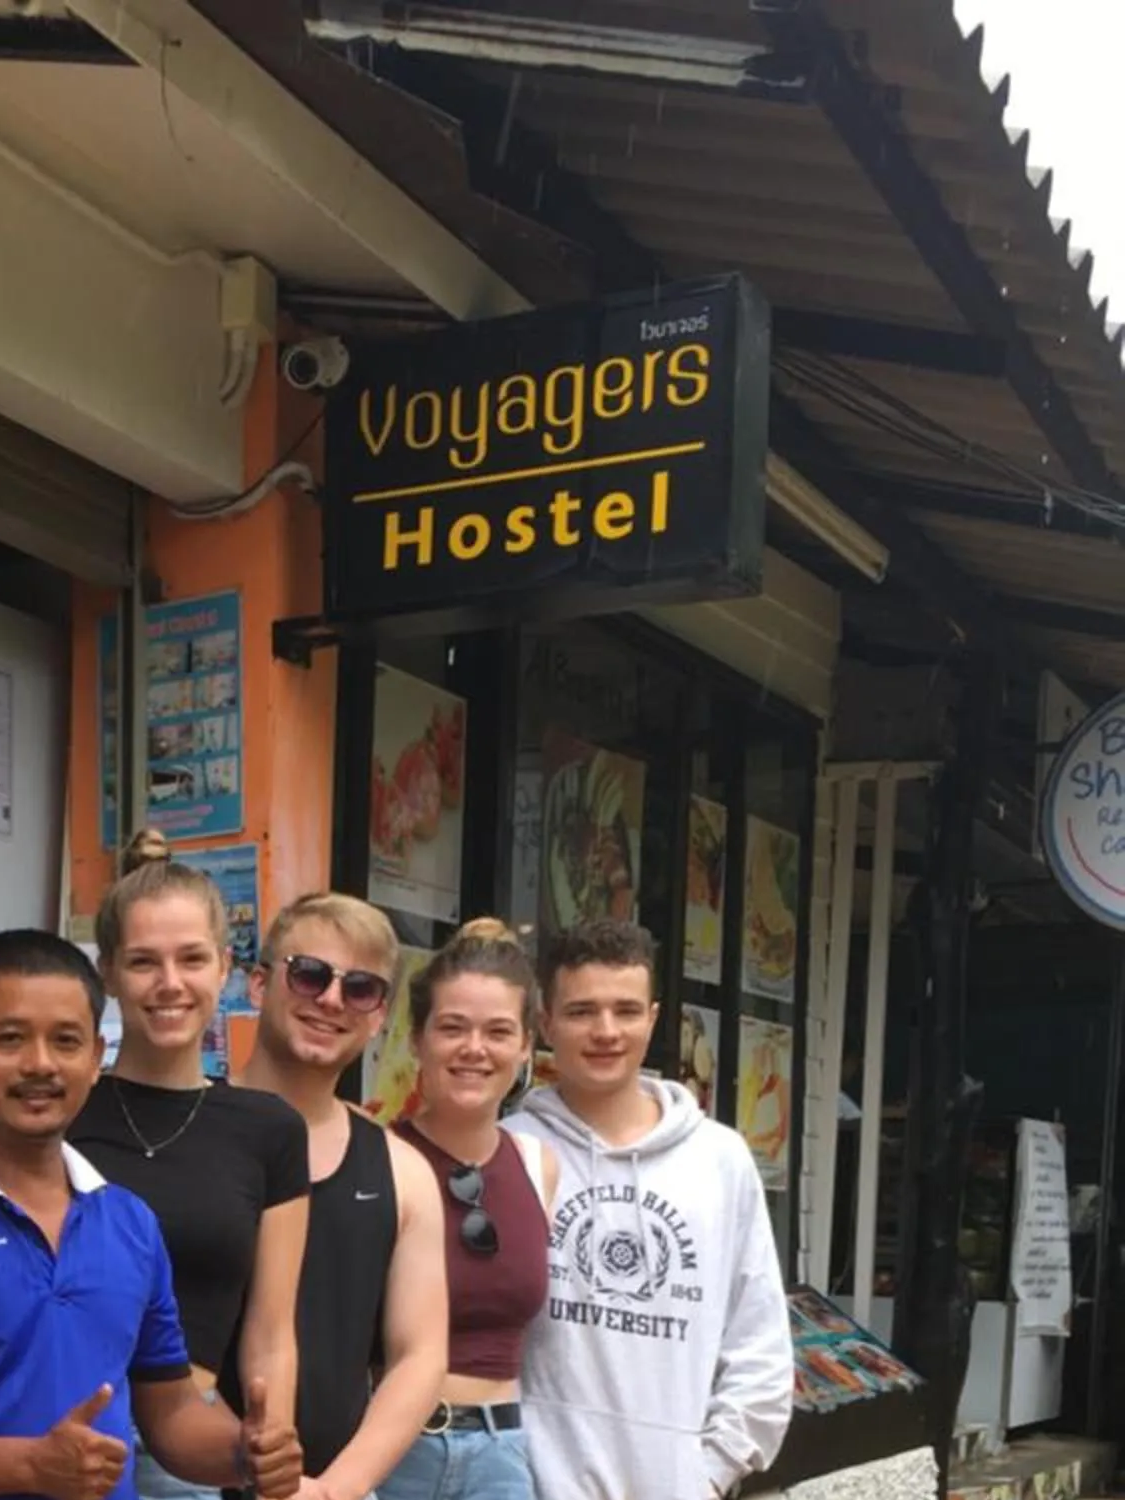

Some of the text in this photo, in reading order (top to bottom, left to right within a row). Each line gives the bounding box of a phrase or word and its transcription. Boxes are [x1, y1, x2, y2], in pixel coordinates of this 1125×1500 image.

[383, 470, 671, 571] Hostel
[642, 1190, 698, 1270] HALLAM
[549, 1297, 689, 1342] UNIVERSITY
[670, 1283, 703, 1302] 1843
